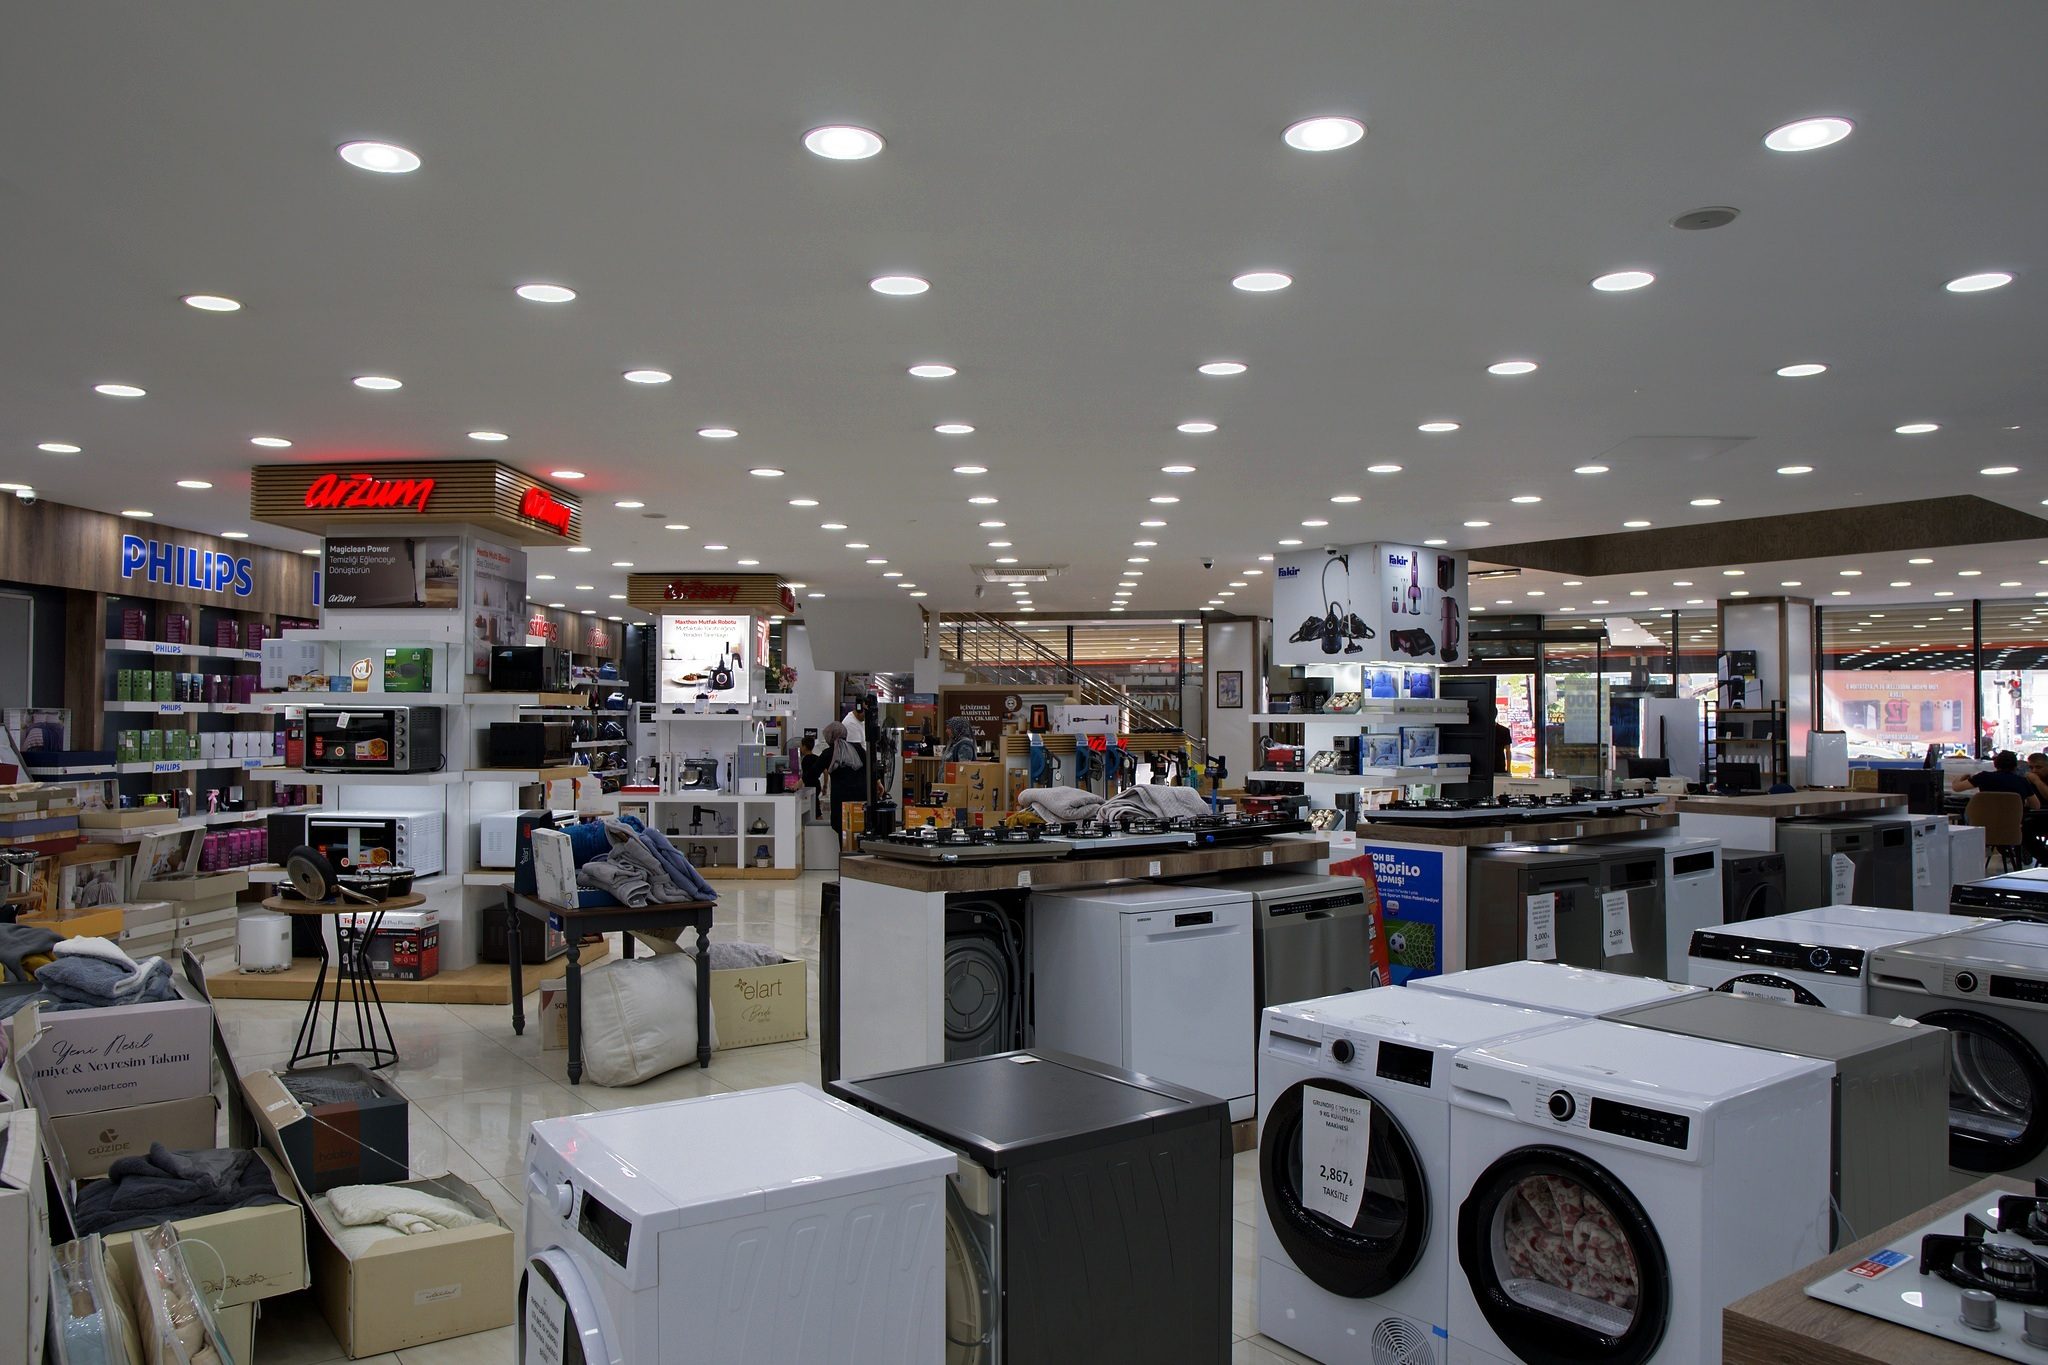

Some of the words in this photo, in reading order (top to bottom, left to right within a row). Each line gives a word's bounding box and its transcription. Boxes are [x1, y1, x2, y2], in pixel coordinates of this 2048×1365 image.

[305, 472, 436, 513] arzum
[329, 545, 366, 555] Magiclean
[367, 545, 390, 553] Power
[121, 533, 253, 598] PHILIPS
[359, 555, 396, 566] Eğlenceye
[1389, 554, 1408, 566] Fakir
[1278, 566, 1300, 577] Fakir
[155, 644, 181, 654] PHILIPS
[245, 651, 262, 659] PHILIPS
[155, 763, 181, 772] PHILIPS
[1373, 853, 1384, 861] OH
[1373, 862, 1420, 877] PROFİLO
[744, 979, 782, 1000] elart
[53, 1040, 98, 1065] Yeni
[104, 1034, 153, 1056] Nesil
[72, 1064, 82, 1073] &
[88, 1057, 146, 1072] Nevresim
[65, 1080, 138, 1095] www.elart.com
